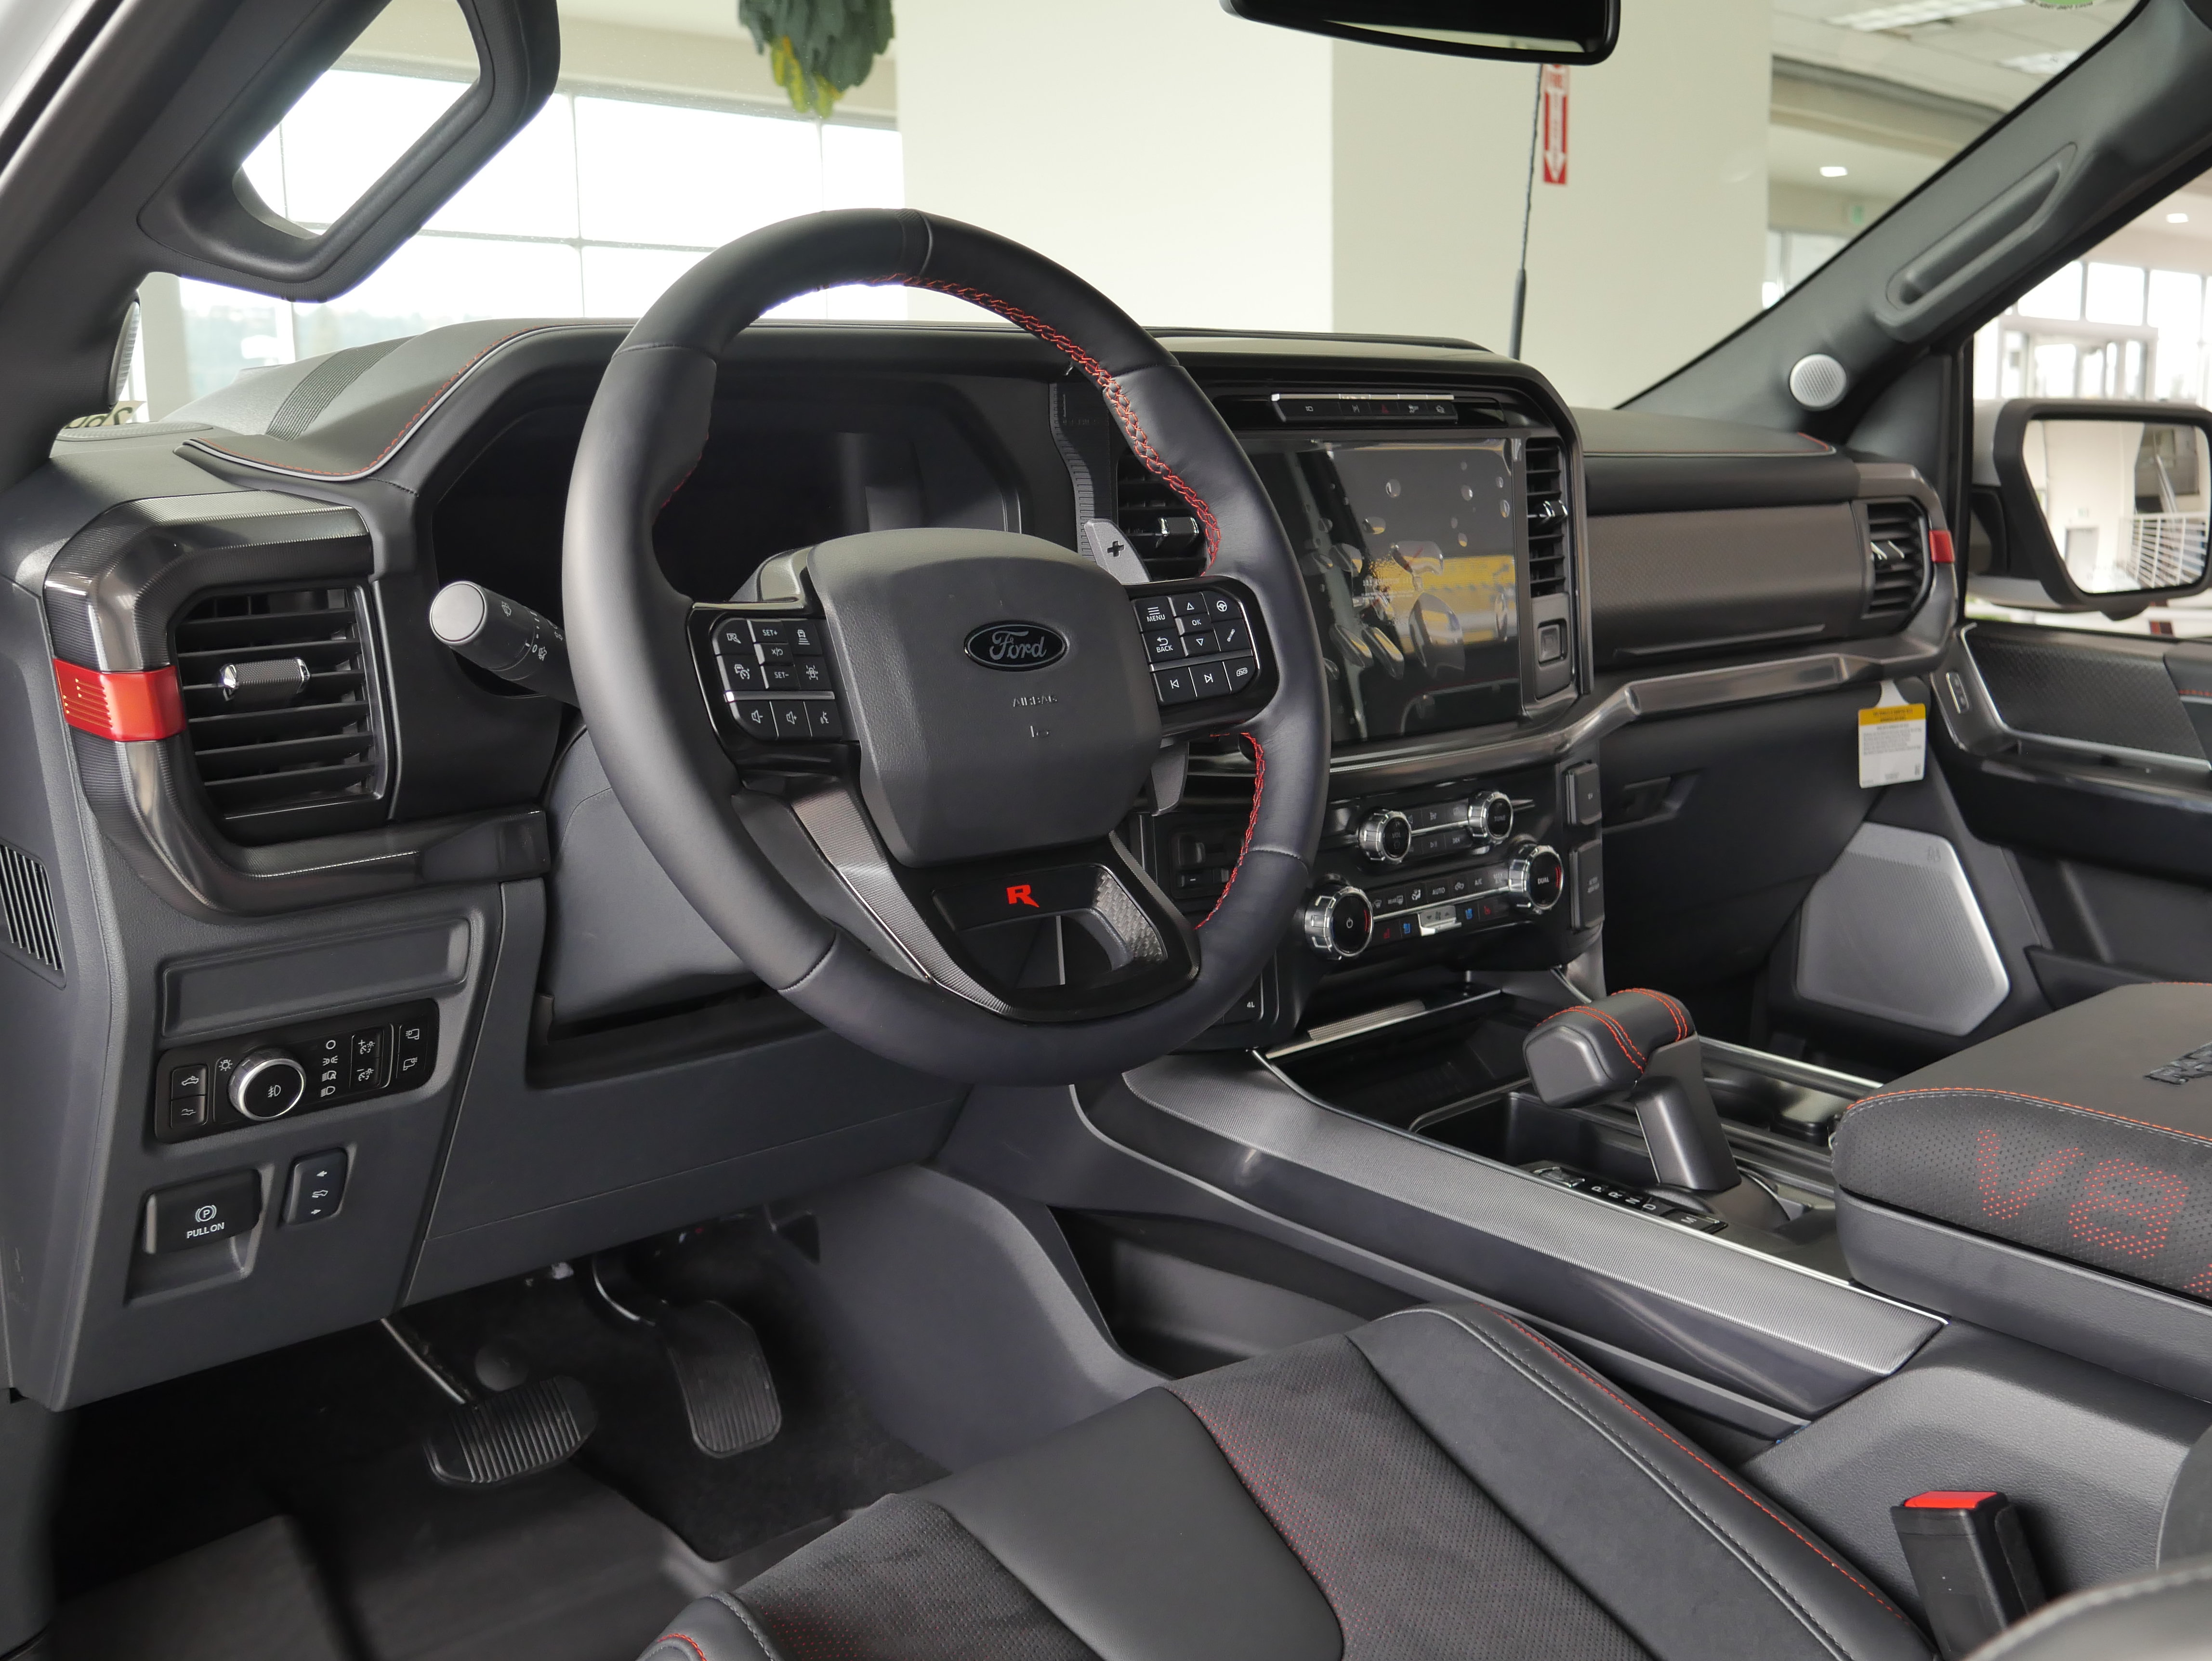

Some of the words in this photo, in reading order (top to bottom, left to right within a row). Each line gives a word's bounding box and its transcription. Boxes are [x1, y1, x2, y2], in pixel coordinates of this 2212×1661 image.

[989, 631, 1046, 660] Ford
[1006, 884, 1040, 908] R
[1432, 887, 1445, 895] AUTO
[186, 1227, 210, 1239] PULL
[210, 1222, 225, 1232] ON
